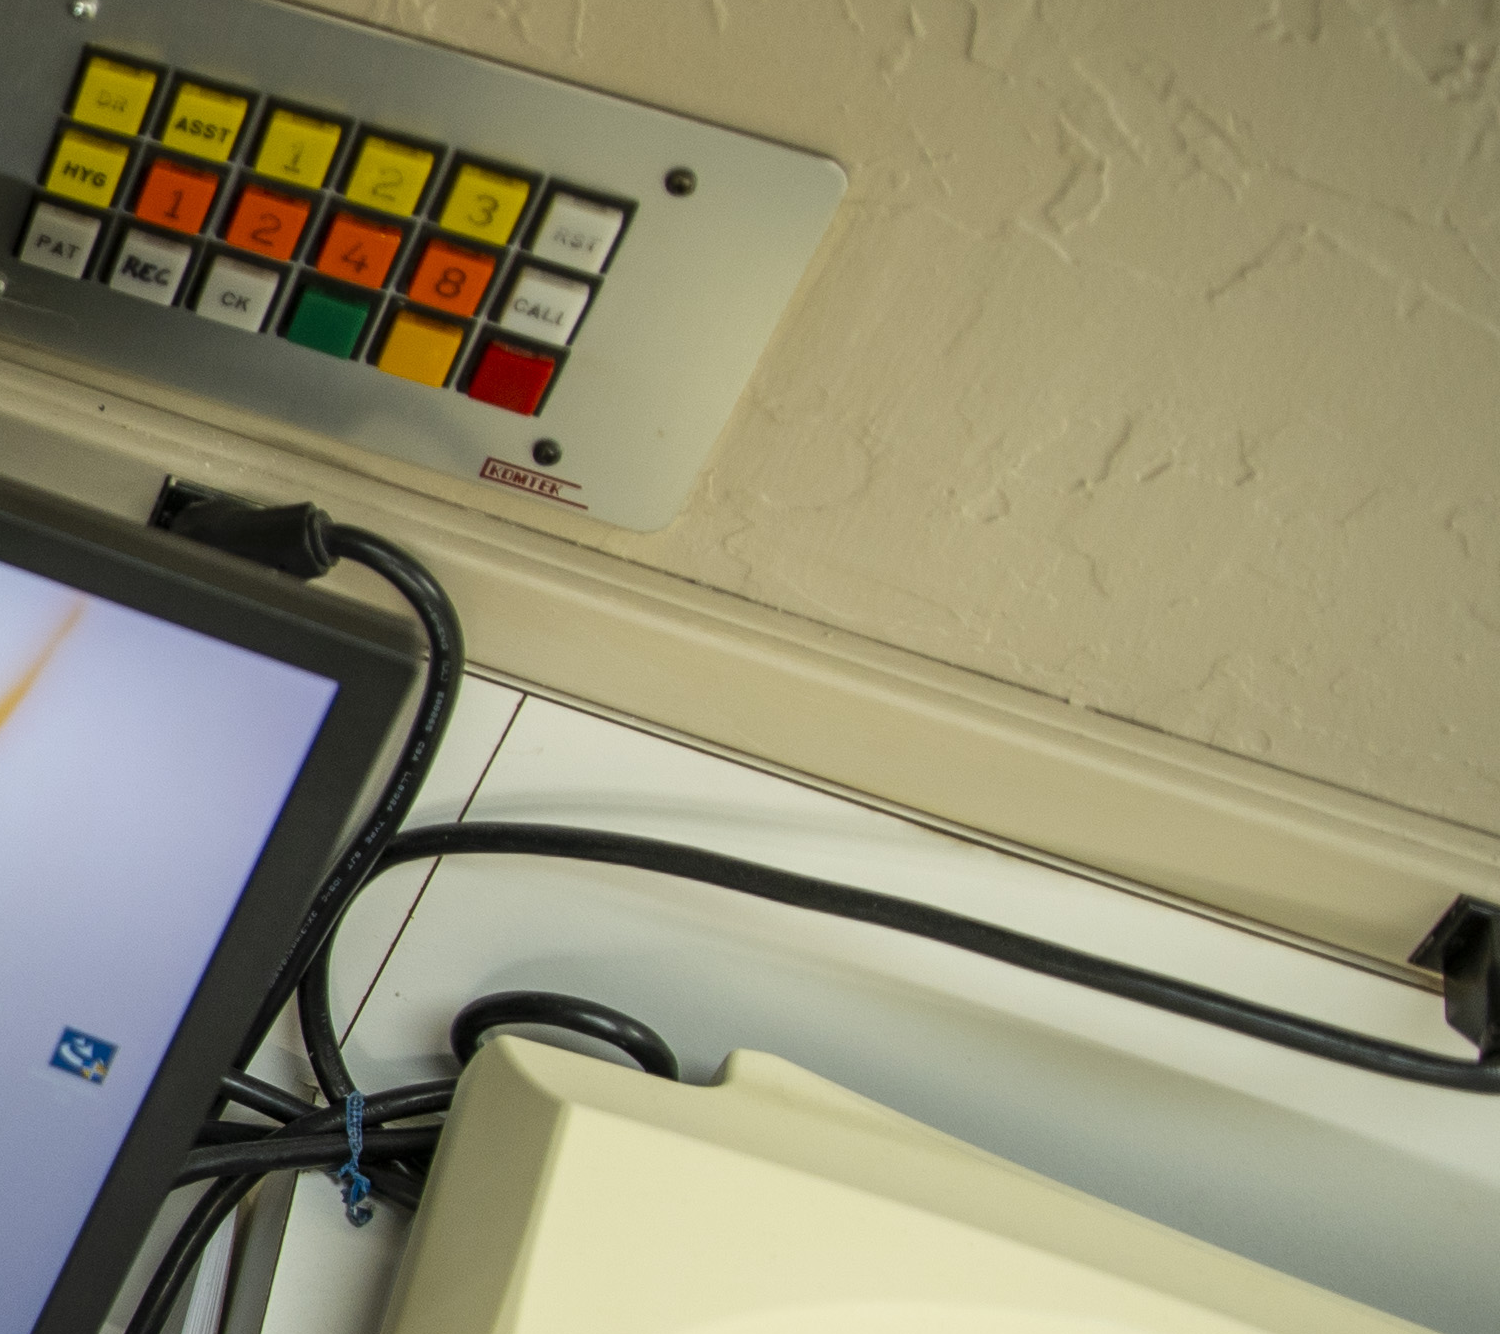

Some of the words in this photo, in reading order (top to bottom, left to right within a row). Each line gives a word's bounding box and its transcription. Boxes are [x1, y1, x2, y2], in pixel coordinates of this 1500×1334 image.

[174, 116, 233, 144] ASST
[61, 160, 107, 188] HYG
[371, 170, 405, 200] 2
[164, 190, 183, 219] 1
[466, 194, 499, 227] 3
[249, 212, 282, 246] 2
[37, 235, 81, 261] PAT
[340, 240, 369, 272] 4
[435, 267, 466, 299] 8
[221, 291, 249, 313] CK
